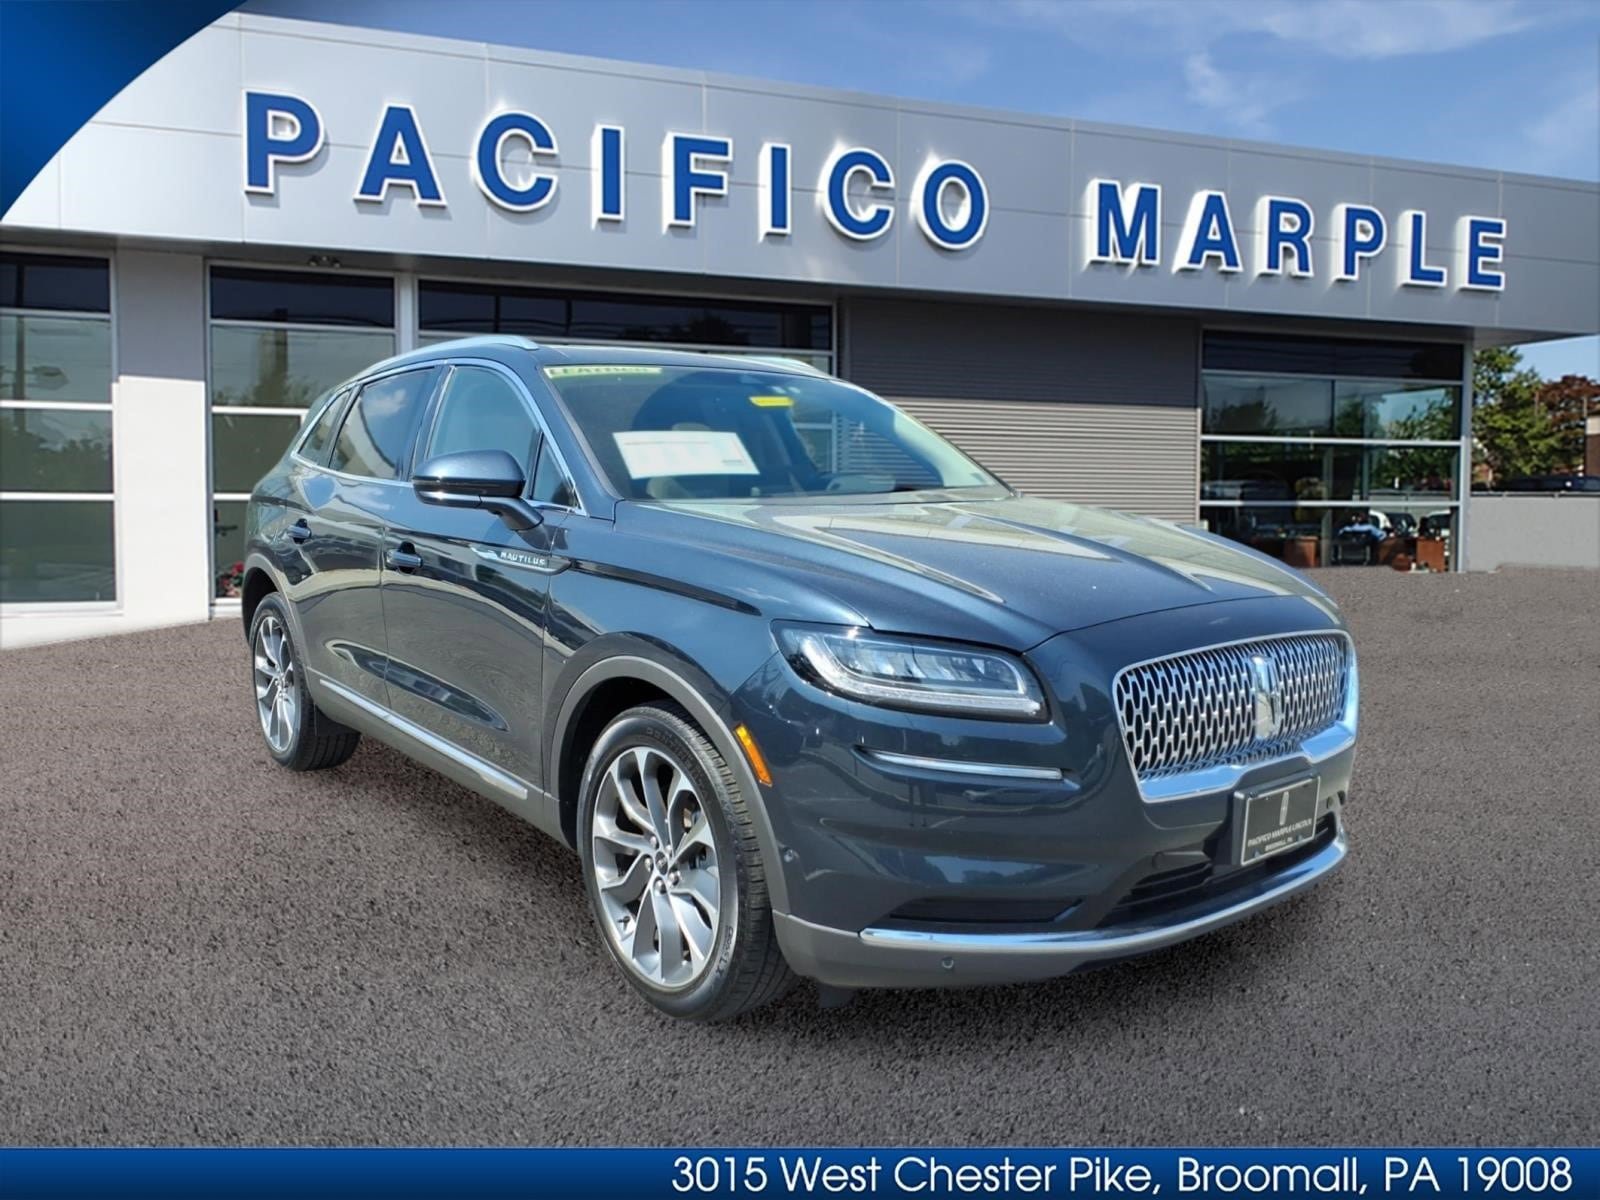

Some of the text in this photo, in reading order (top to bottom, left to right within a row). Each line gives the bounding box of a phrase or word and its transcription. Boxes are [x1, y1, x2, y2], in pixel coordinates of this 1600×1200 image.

[242, 88, 1506, 292] PACIFICO MARPLE
[500, 551, 546, 566] NAUTILUS
